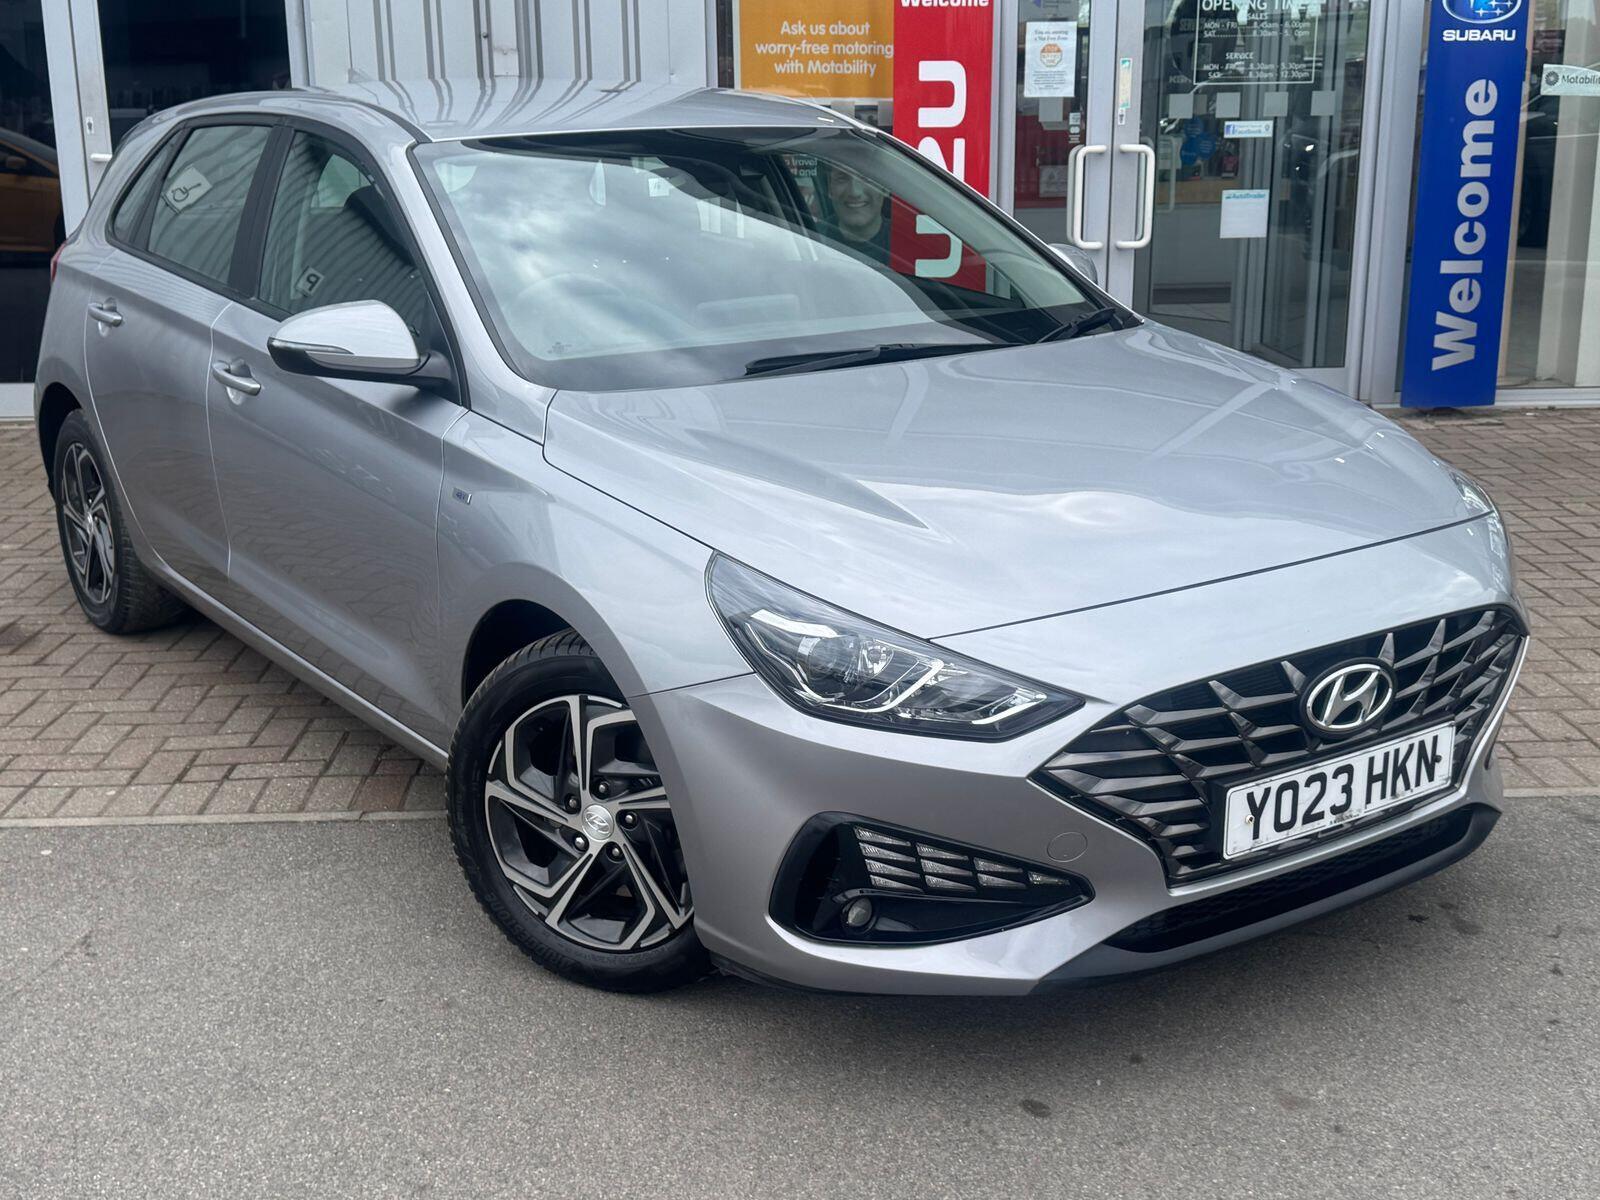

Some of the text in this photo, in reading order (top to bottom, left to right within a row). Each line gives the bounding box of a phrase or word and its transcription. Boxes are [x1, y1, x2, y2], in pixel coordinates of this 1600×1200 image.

[1202, 0, 1268, 11] OPENNG
[780, 20, 871, 36] Ask us about
[1442, 29, 1517, 42] SUBARU
[755, 40, 894, 59] worry-free motoring
[774, 59, 877, 79] with Motability
[1431, 78, 1499, 372] Welcome
[1246, 735, 1439, 841] YO23 HKN
